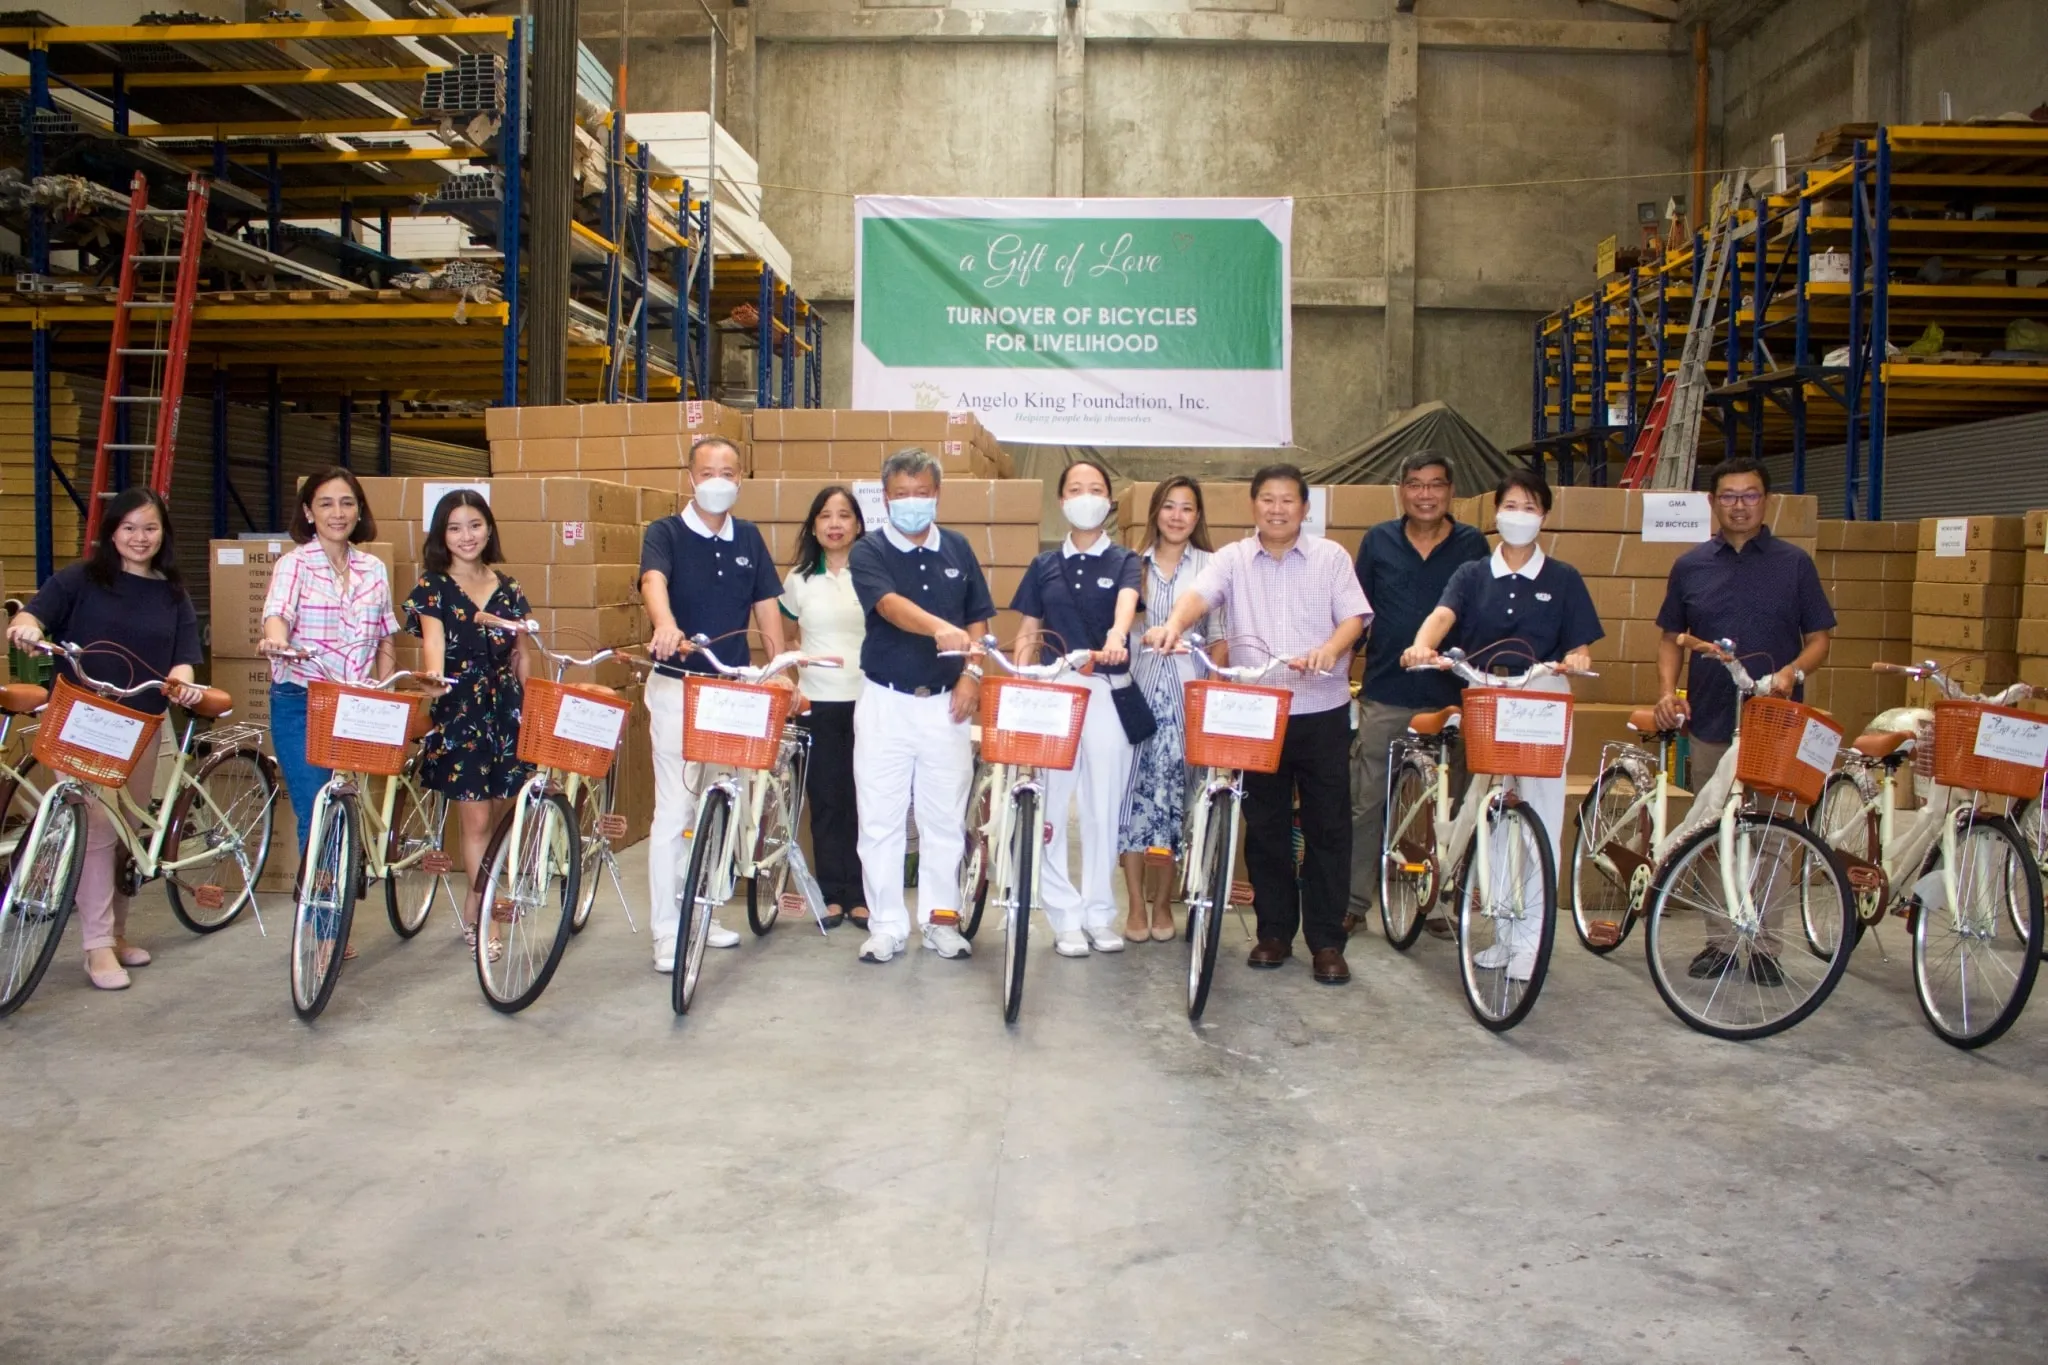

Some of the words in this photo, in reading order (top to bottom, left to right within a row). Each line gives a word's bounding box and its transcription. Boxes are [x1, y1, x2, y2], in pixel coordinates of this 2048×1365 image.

[959, 253, 977, 272] a
[983, 233, 1049, 289] Gift
[1055, 242, 1085, 288] of
[1089, 232, 1163, 286] Love
[946, 306, 1056, 326] TURNOVER
[1062, 307, 1092, 326] OF
[1099, 307, 1198, 326] BICYCLES
[985, 334, 1026, 352] FOR
[1033, 334, 1159, 353] LIVELIHOOD
[957, 391, 1018, 412] Angelo
[1024, 392, 1066, 413] King
[1072, 391, 1172, 412] Foundation,
[1179, 393, 1210, 410] Inc.
[1014, 412, 1050, 424] Helping
[1051, 413, 1081, 424] people
[1083, 412, 1102, 424] help
[1104, 412, 1153, 424] themselves
[1668, 500, 1687, 508] GMA
[1655, 520, 1664, 528] 20
[1665, 520, 1699, 528] BICYCLES
